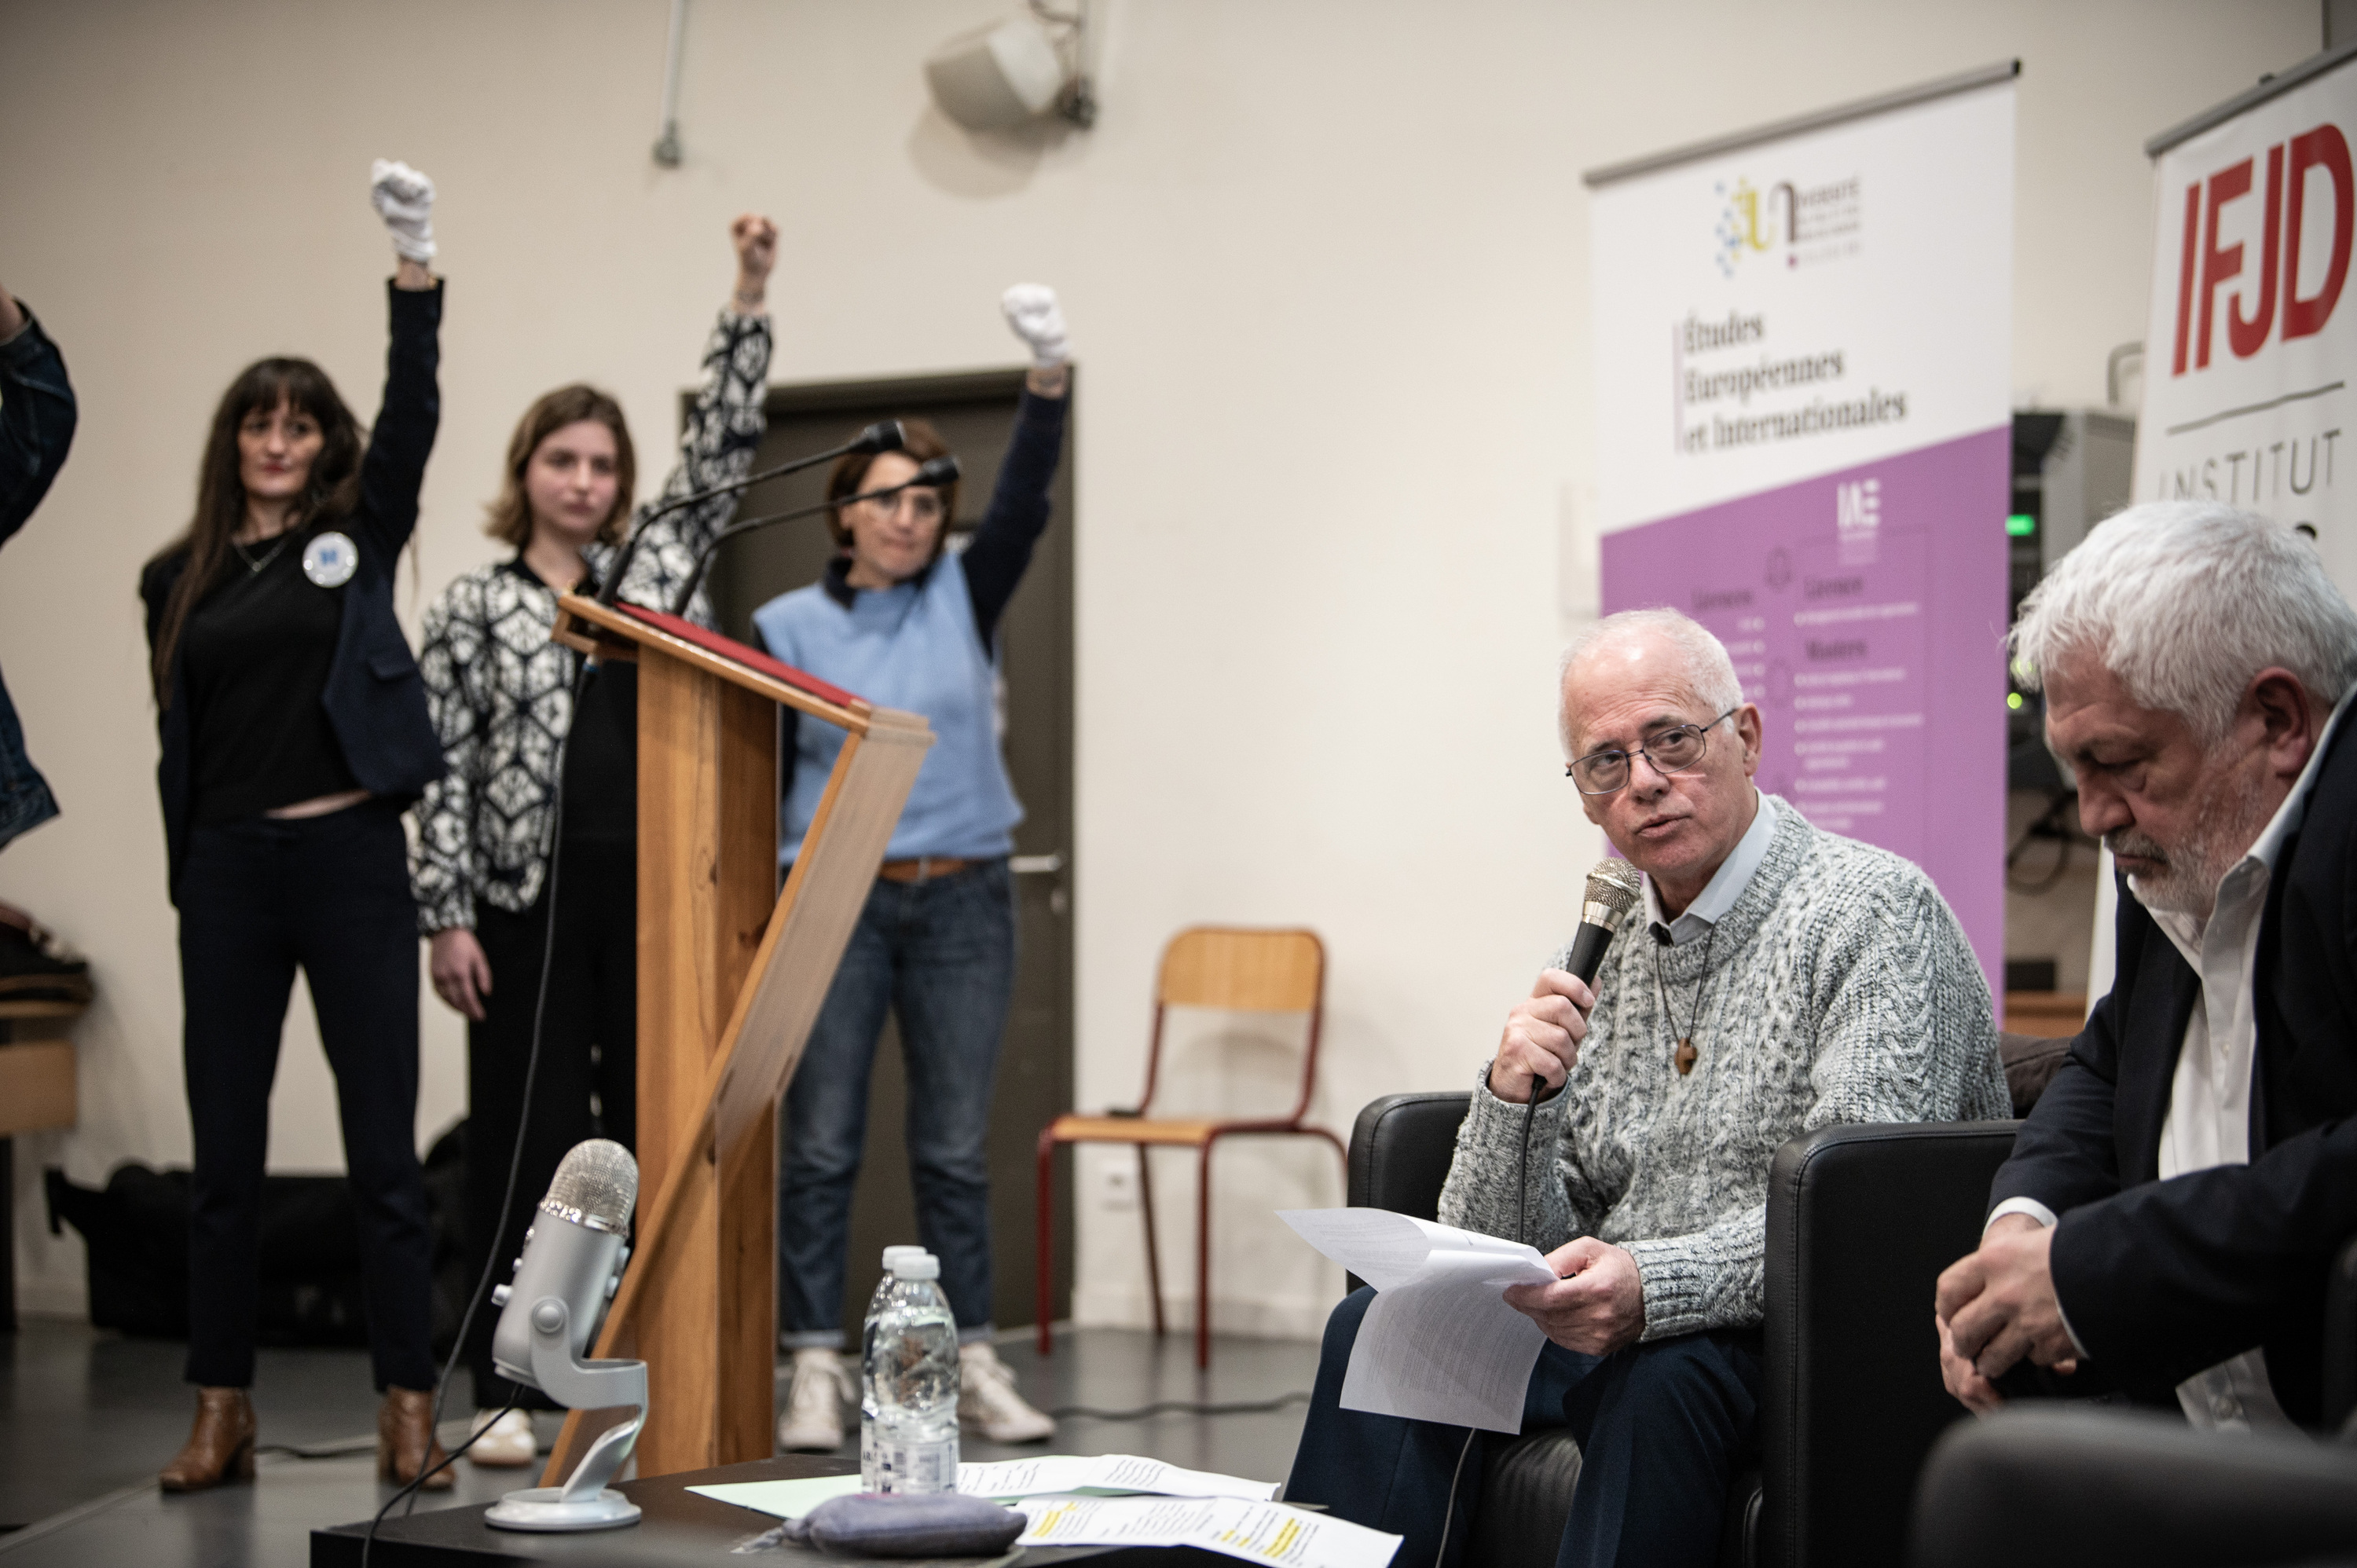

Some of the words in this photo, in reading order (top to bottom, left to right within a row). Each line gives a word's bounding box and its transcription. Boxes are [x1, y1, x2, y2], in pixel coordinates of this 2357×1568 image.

[2172, 123, 2354, 376] IFJD
[1684, 309, 1763, 353] Études
[1684, 350, 1844, 405] Européennes
[1684, 423, 1708, 453] et
[1713, 390, 1907, 449] Internationales
[2158, 429, 2341, 503] INSTITUT
